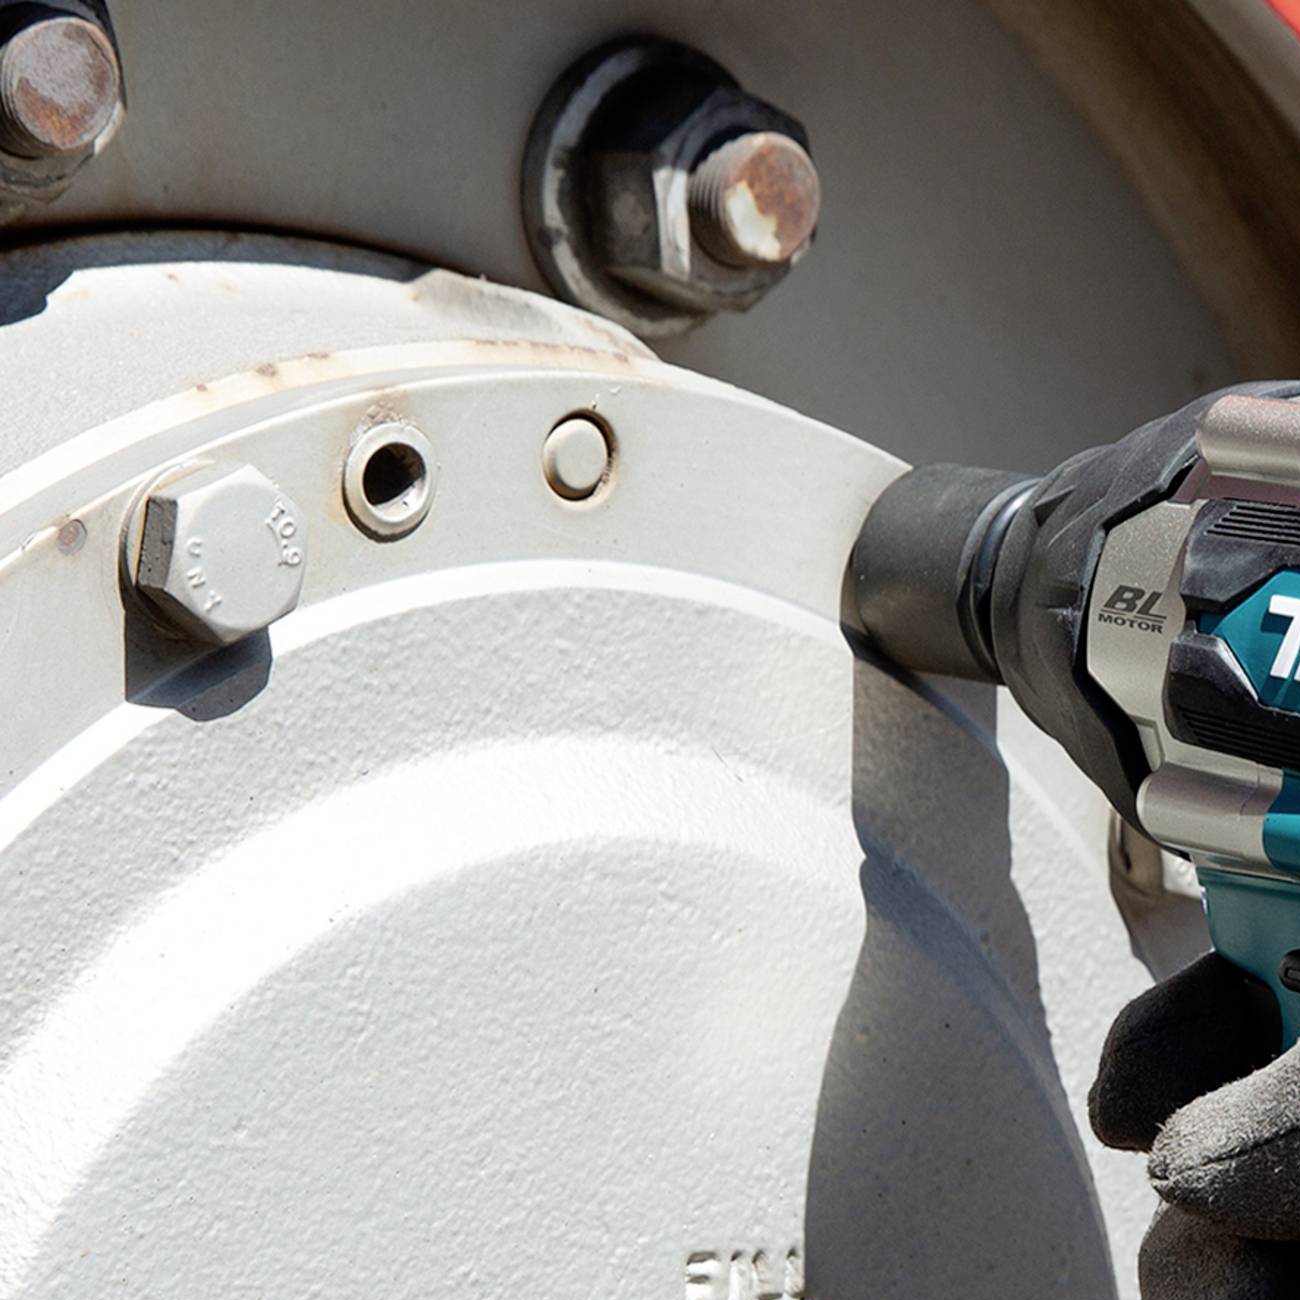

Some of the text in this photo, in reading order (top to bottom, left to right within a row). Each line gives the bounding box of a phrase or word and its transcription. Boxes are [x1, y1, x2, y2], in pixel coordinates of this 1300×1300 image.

[265, 498, 302, 567] 10.9
[1103, 584, 1168, 620] BL
[1098, 612, 1163, 635] MOTOR
